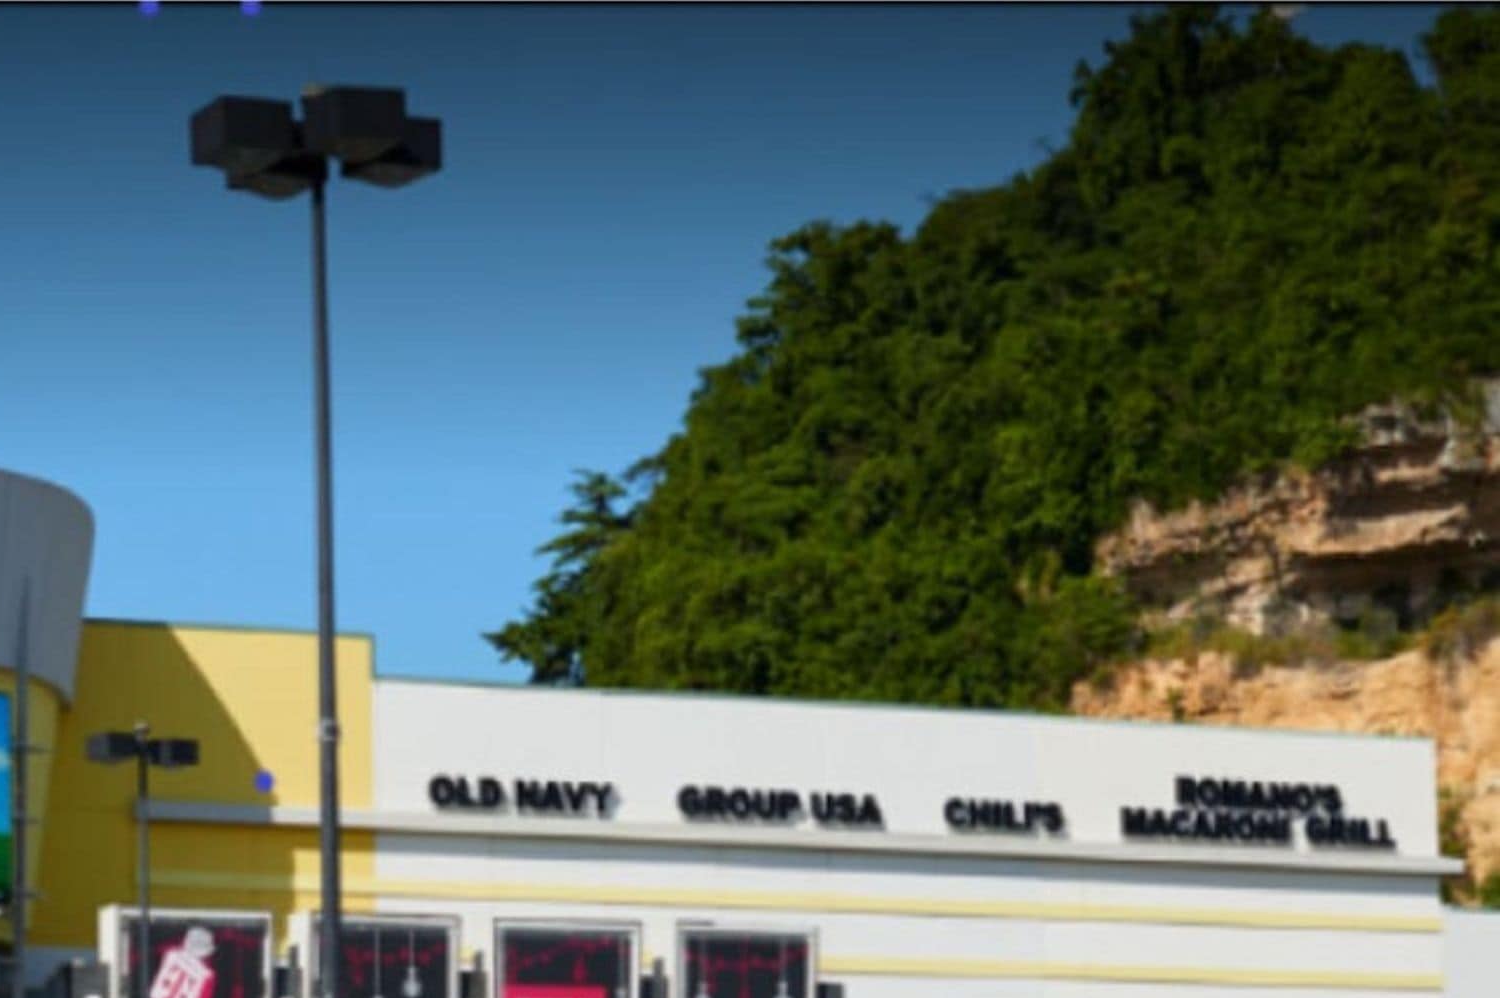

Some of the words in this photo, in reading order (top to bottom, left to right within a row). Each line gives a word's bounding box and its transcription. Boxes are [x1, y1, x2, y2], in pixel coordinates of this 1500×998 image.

[428, 774, 503, 811] OLD
[514, 780, 613, 818] NAVY
[677, 785, 800, 822] GROUP
[810, 793, 884, 829] USA
[944, 798, 1064, 833] CHILI'S
[1175, 776, 1342, 813] ROMANO'S
[1120, 806, 1293, 843] MACARONI
[1306, 817, 1396, 849] GRILL
